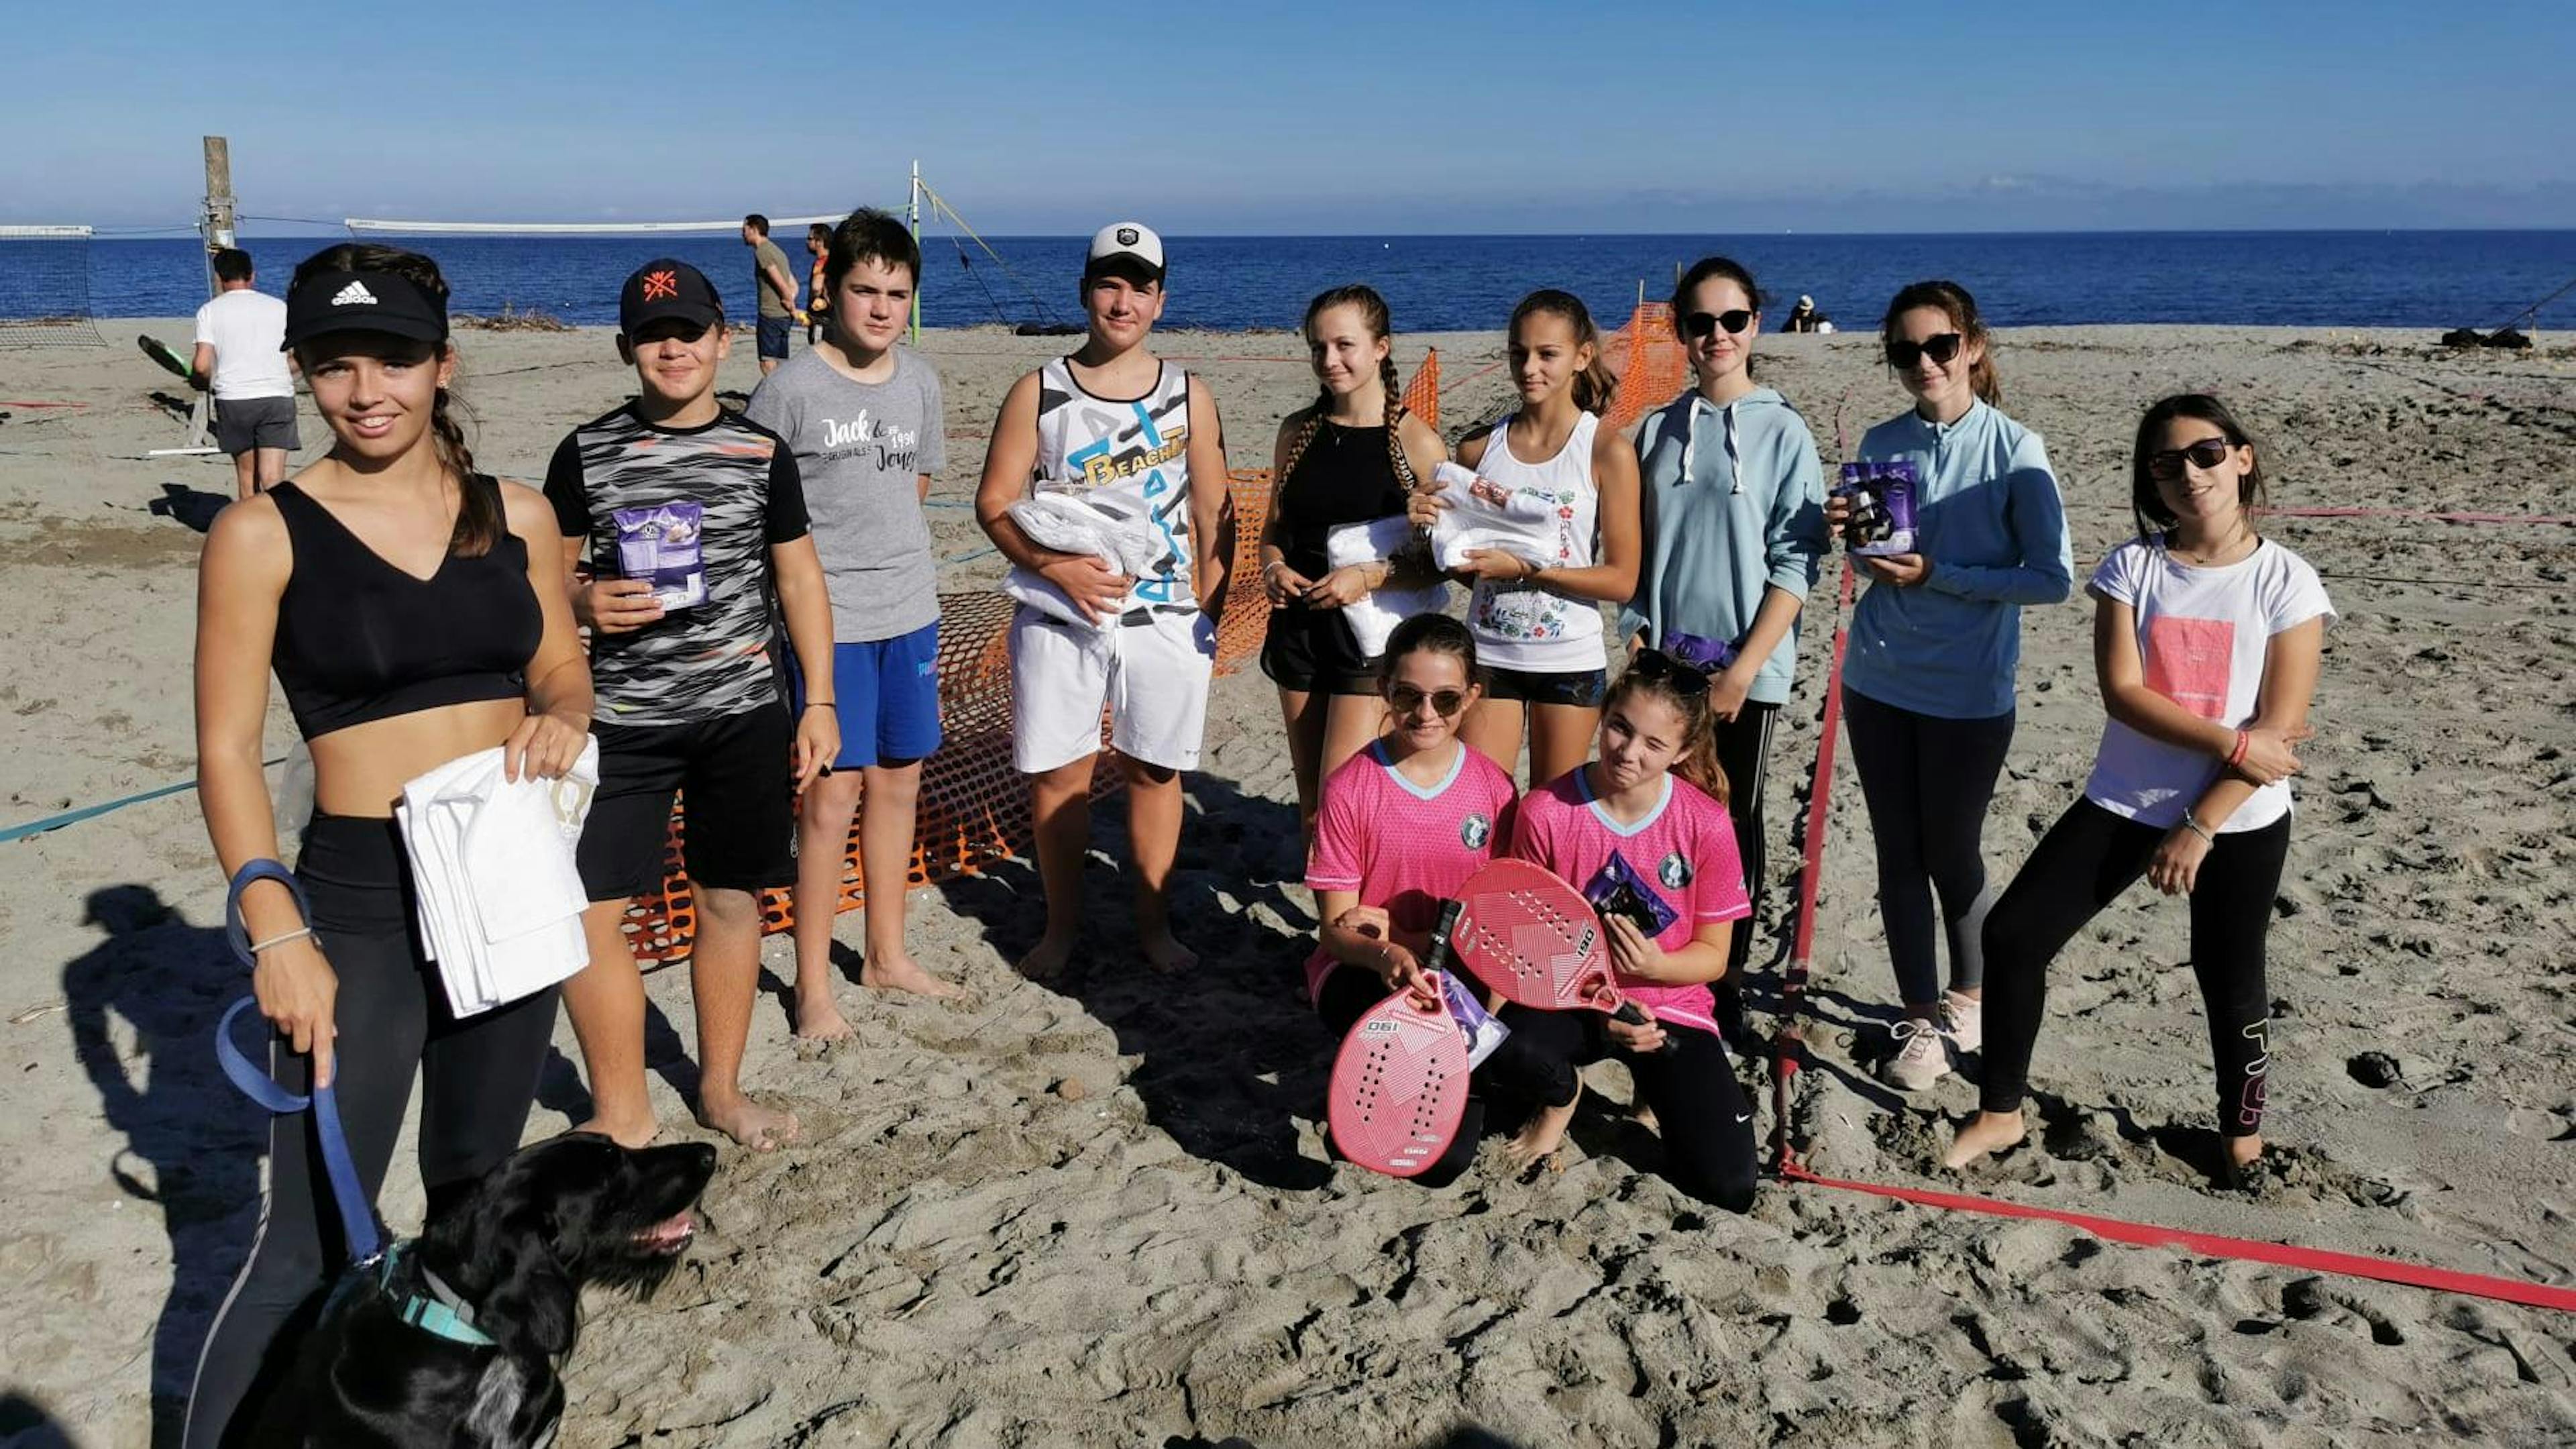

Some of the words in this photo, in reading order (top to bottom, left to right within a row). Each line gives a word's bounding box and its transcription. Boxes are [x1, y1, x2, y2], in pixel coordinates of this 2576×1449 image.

[331, 294, 378, 306] adidas
[822, 409, 871, 447] Jack
[1083, 425, 1187, 488] BEACHT
